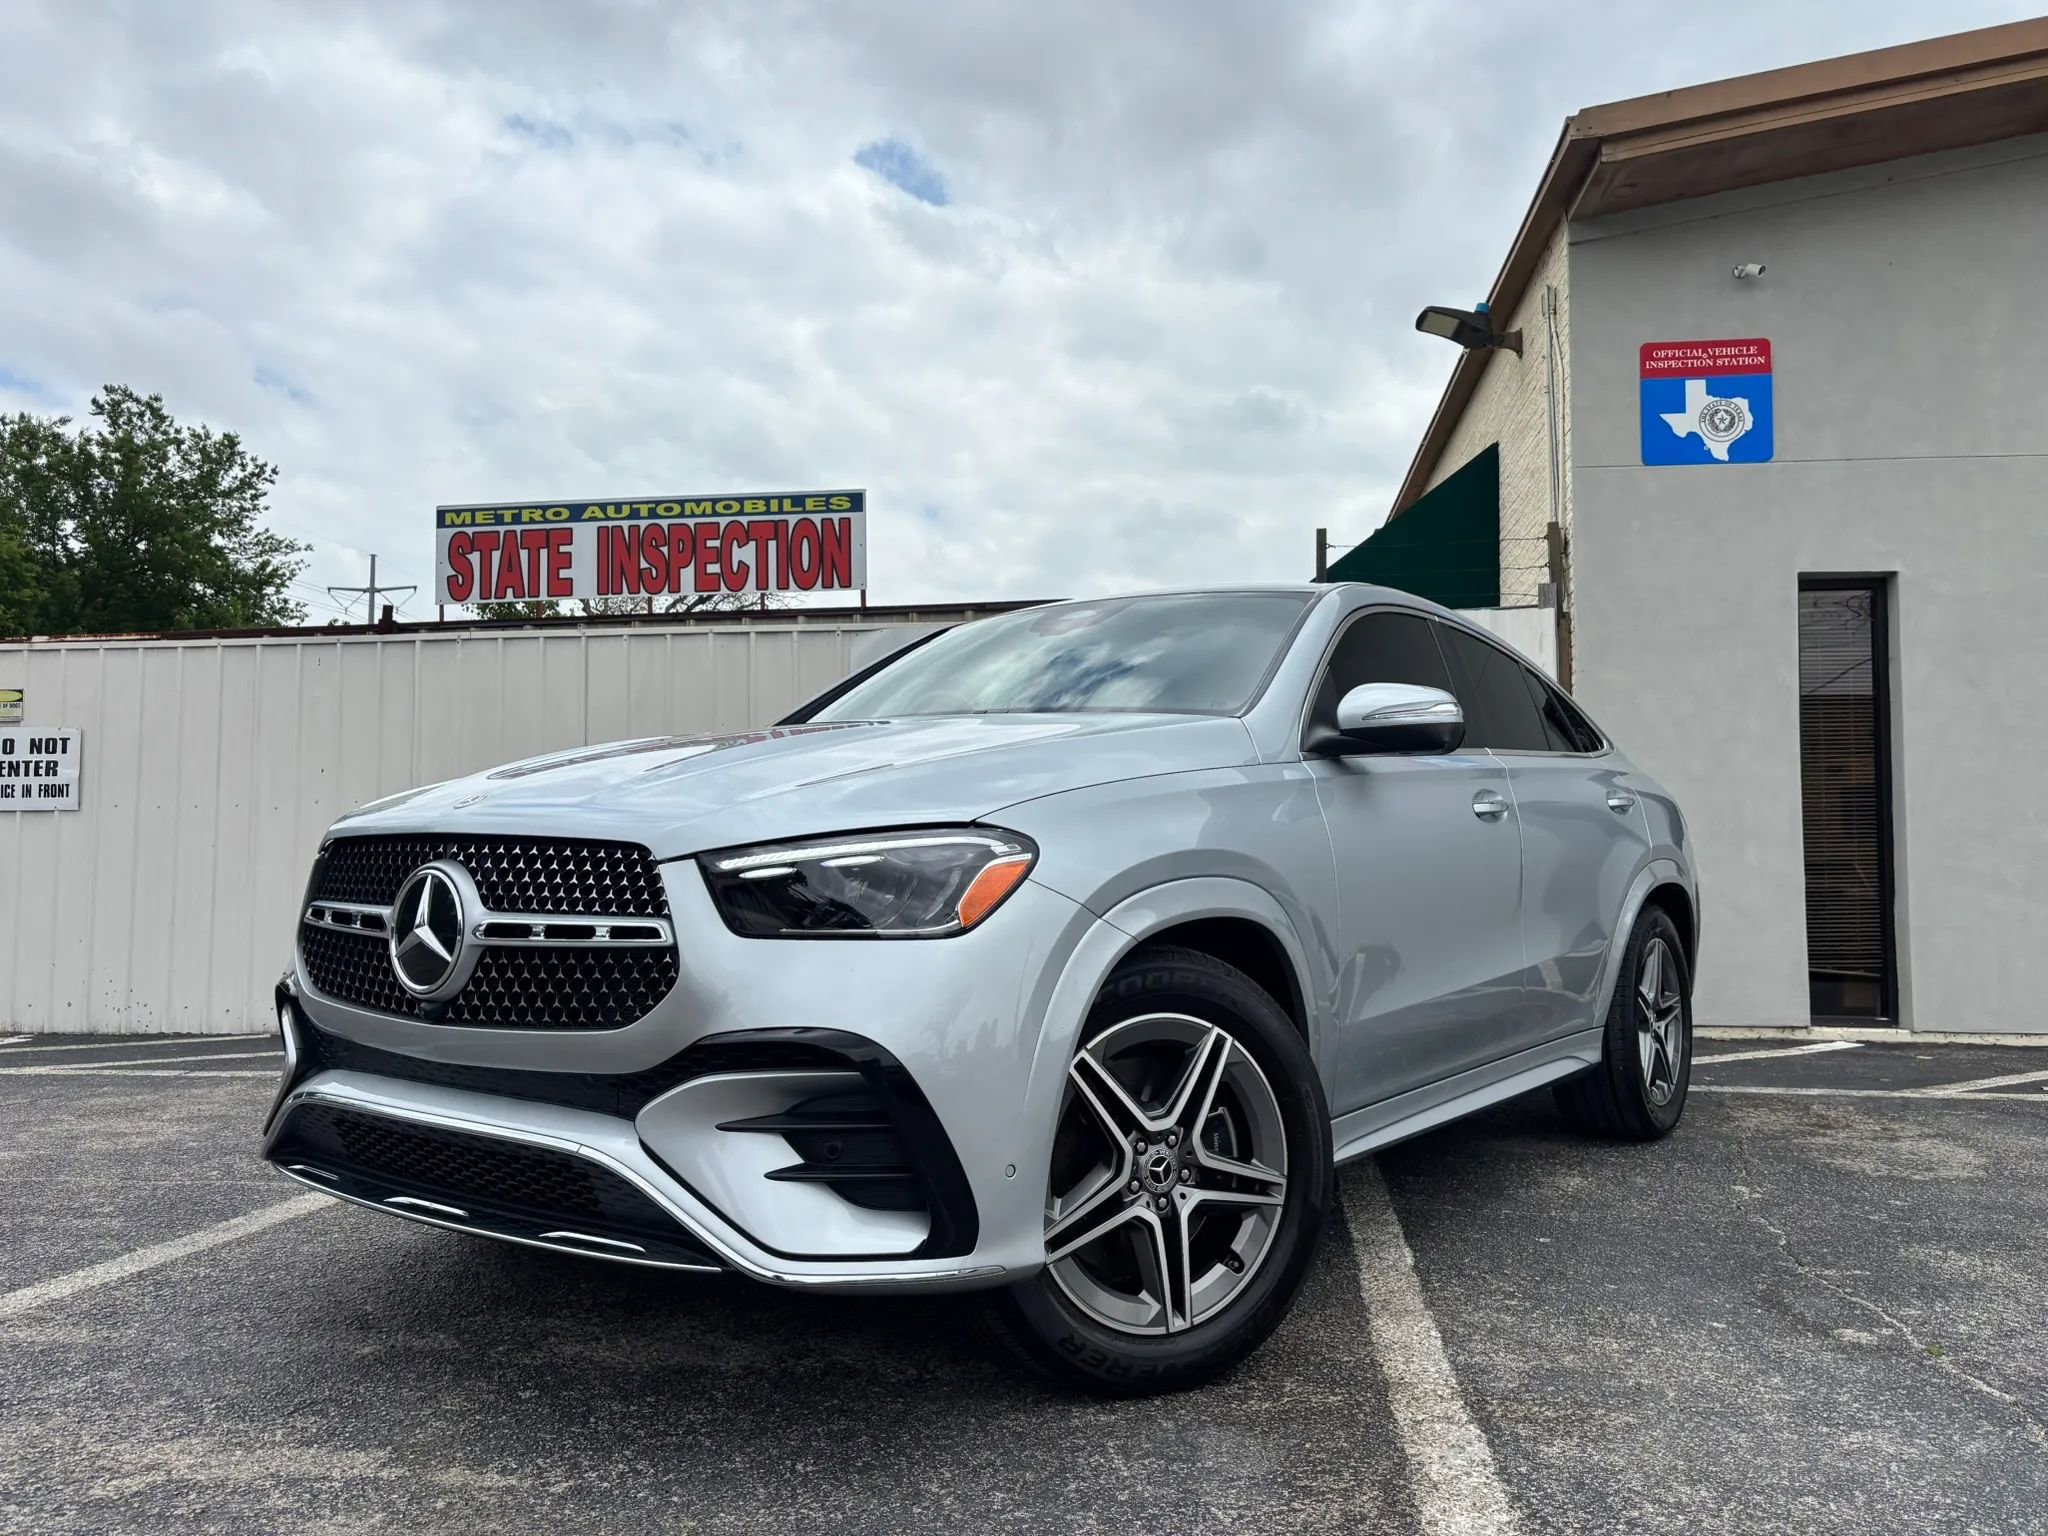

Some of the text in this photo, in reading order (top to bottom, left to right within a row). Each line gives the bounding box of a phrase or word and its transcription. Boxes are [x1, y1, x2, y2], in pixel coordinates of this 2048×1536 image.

[1653, 346, 1758, 358] OFFICIAL VEHICLE
[1645, 356, 1766, 369] INSPECTION STATION
[444, 495, 852, 526] METRO AUTOMOBILES
[447, 517, 852, 602] STATE INSPECTION
[2, 737, 71, 755] O NOT
[0, 760, 59, 777] ENTER
[0, 783, 70, 799] ICE IN FRONT
